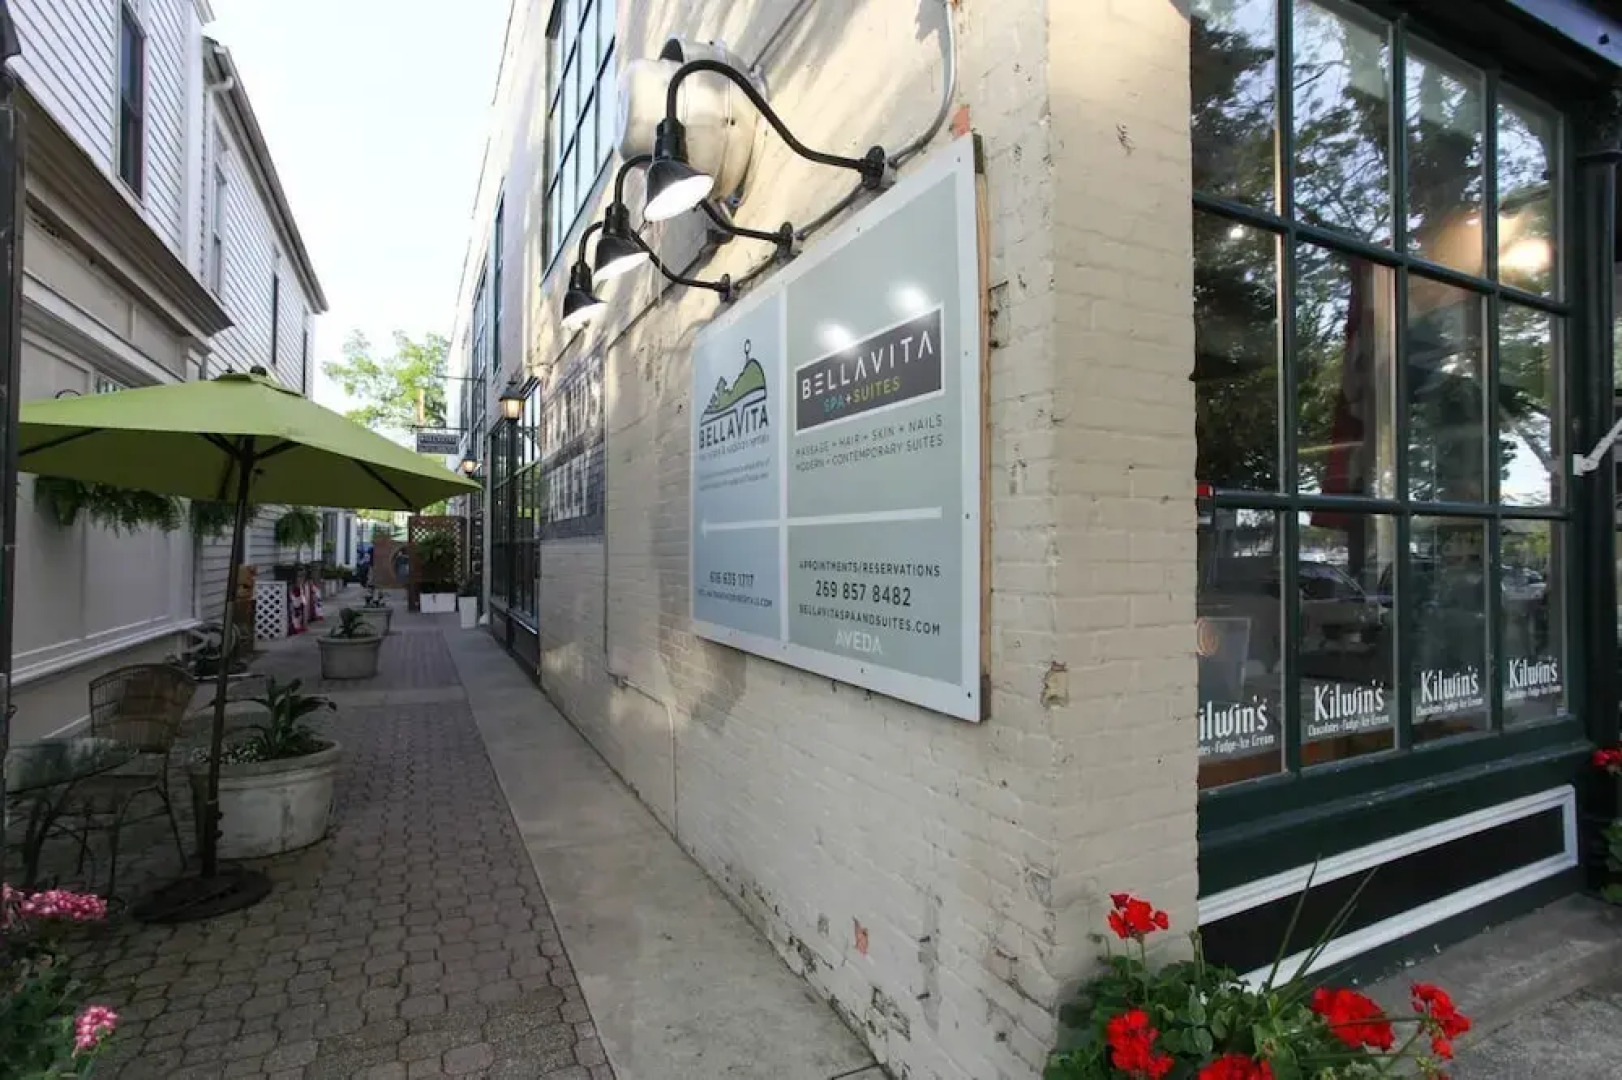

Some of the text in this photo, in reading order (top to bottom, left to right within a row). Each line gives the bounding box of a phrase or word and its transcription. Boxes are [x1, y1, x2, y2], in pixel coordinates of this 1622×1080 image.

[802, 330, 933, 400] BELLAVITA
[698, 404, 769, 449] BELLAVITA
[872, 427, 894, 441] SKIN
[909, 414, 943, 432] NAILS
[832, 442, 902, 466] CONTEMPORARY
[906, 434, 943, 452] SUITES
[815, 579, 912, 607] 269 857 8482
[835, 630, 883, 655] AVEDA
[1314, 679, 1385, 722] Kilwin's
[1421, 665, 1480, 704] Kilwin's
[1199, 694, 1269, 742] ilwin's
